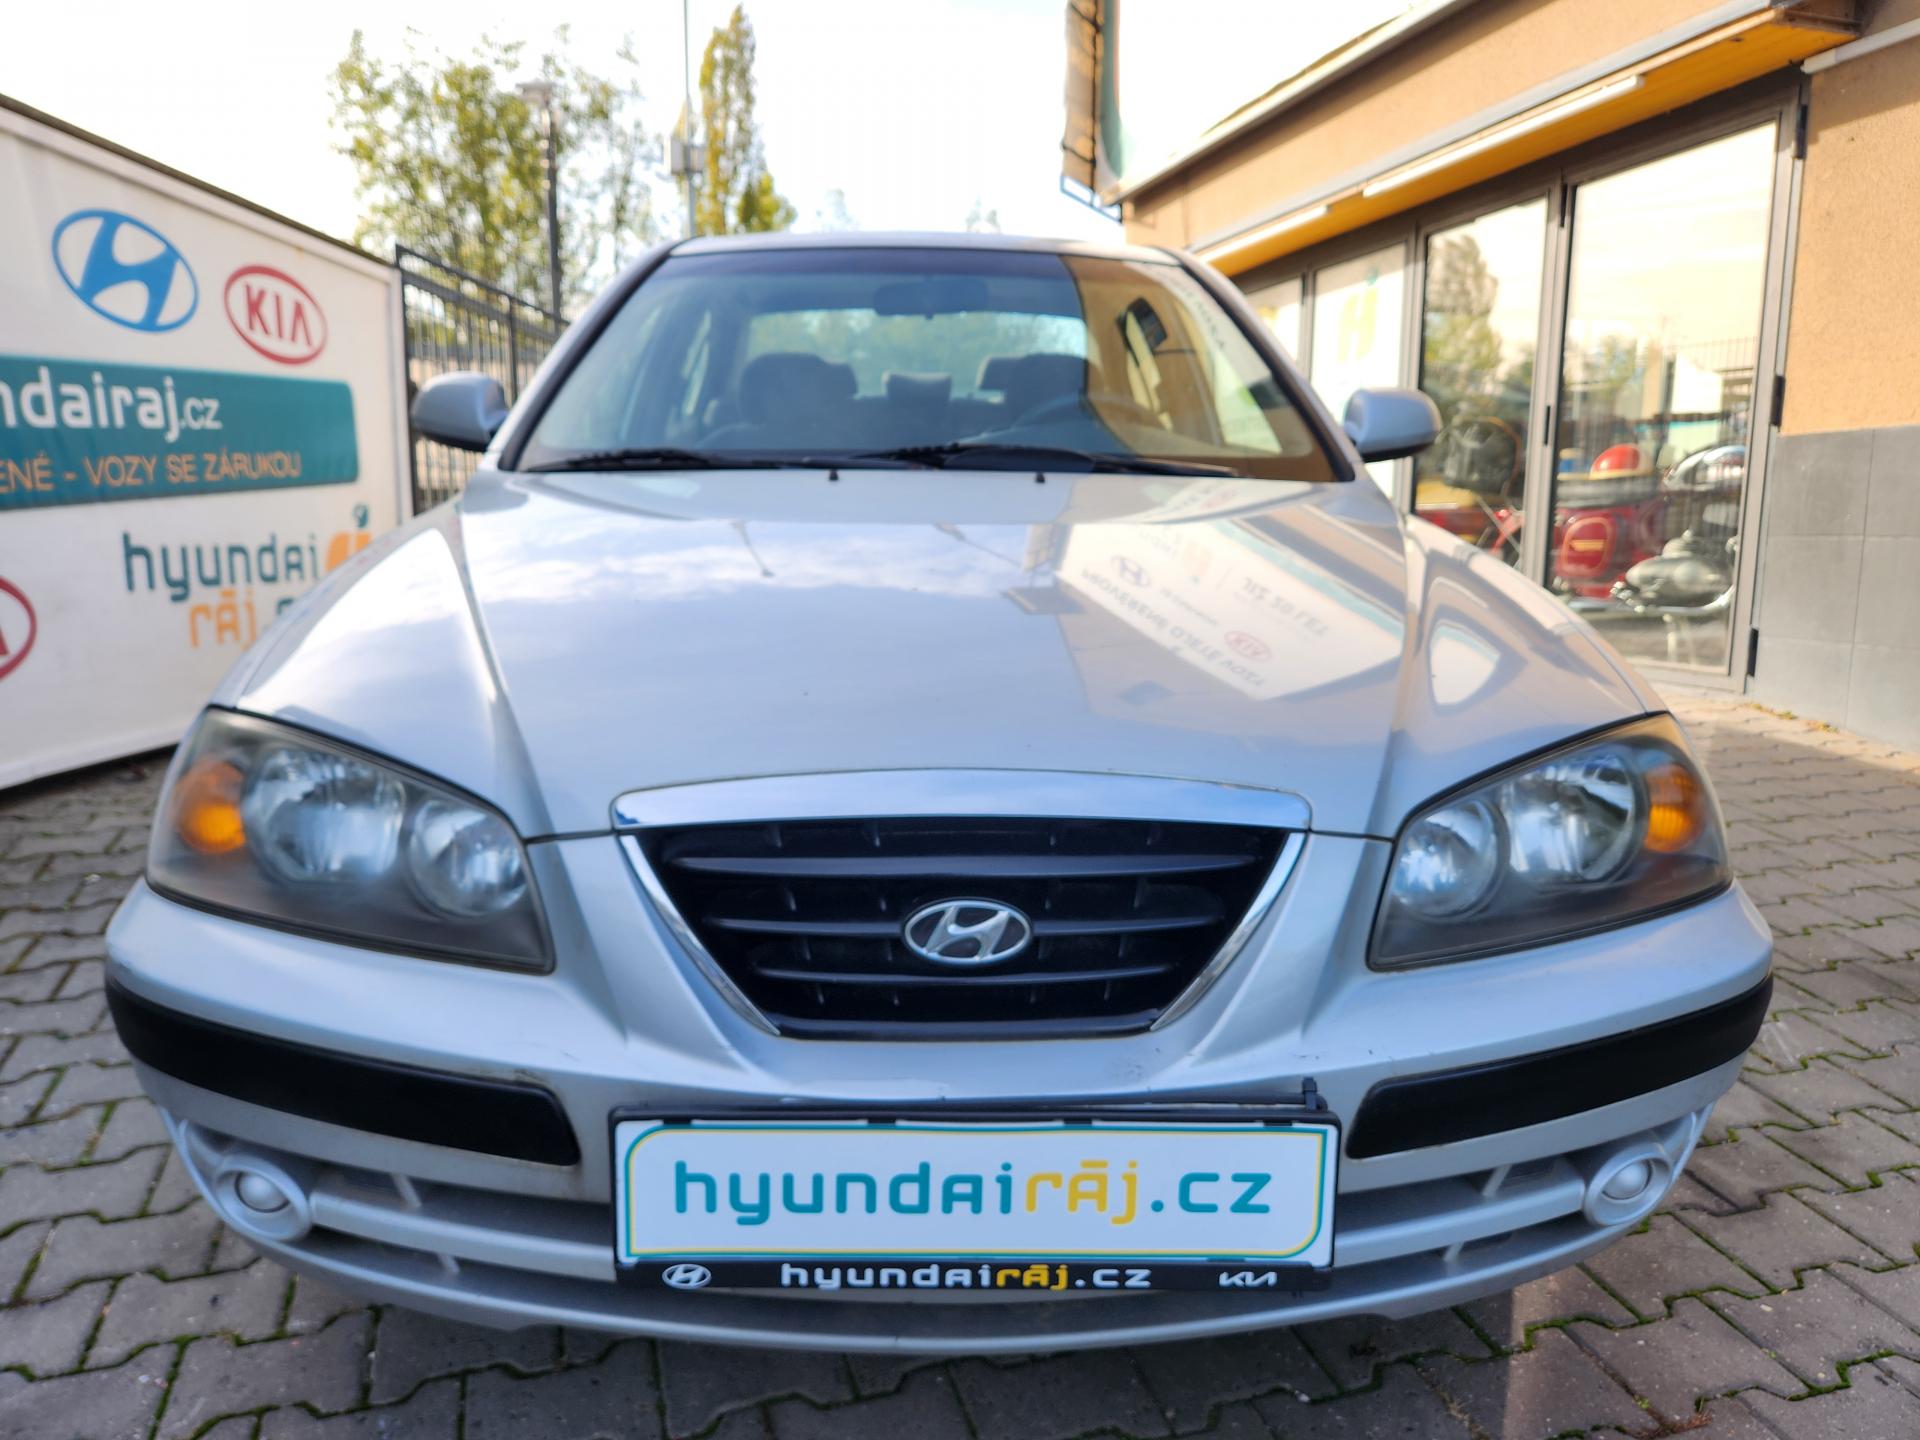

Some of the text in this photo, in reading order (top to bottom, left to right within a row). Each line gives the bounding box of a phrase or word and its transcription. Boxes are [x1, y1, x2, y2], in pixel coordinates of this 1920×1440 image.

[244, 284, 313, 347] KIA
[83, 454, 158, 487] VOZY
[165, 453, 199, 483] SE
[202, 447, 302, 482] ZÁRUKOU
